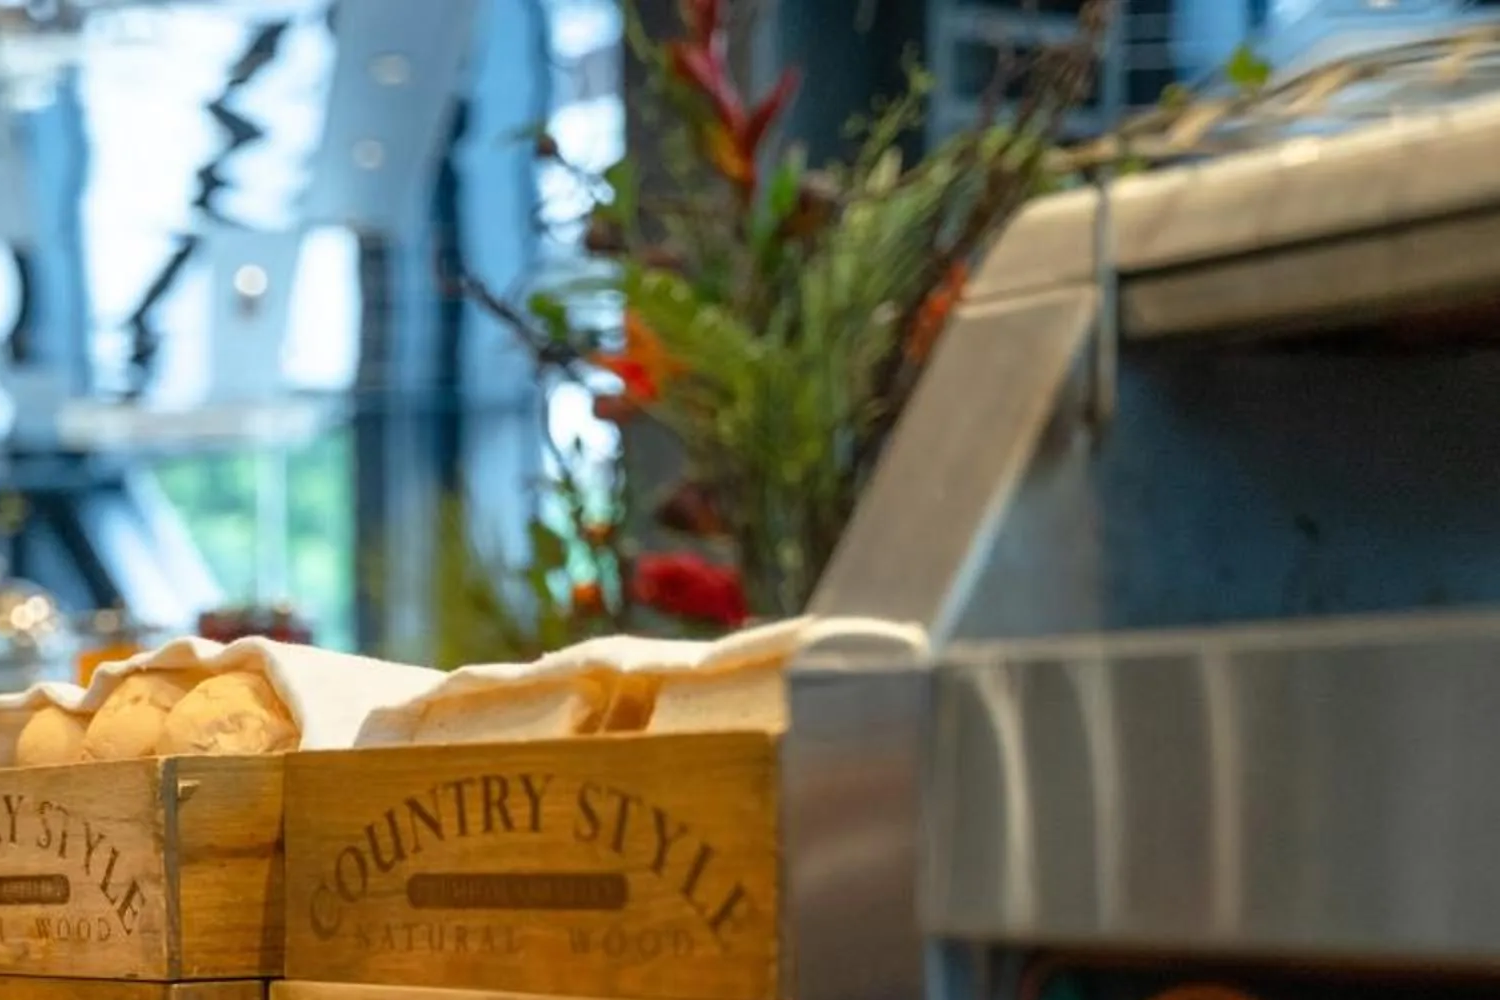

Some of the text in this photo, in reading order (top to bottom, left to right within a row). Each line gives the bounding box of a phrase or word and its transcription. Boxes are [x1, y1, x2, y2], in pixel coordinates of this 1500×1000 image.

[35, 800, 146, 935] STYLE
[308, 772, 747, 953] COUNTRY STYLE
[35, 915, 113, 944] WOOD
[354, 924, 696, 960] NATURAL WOOD
